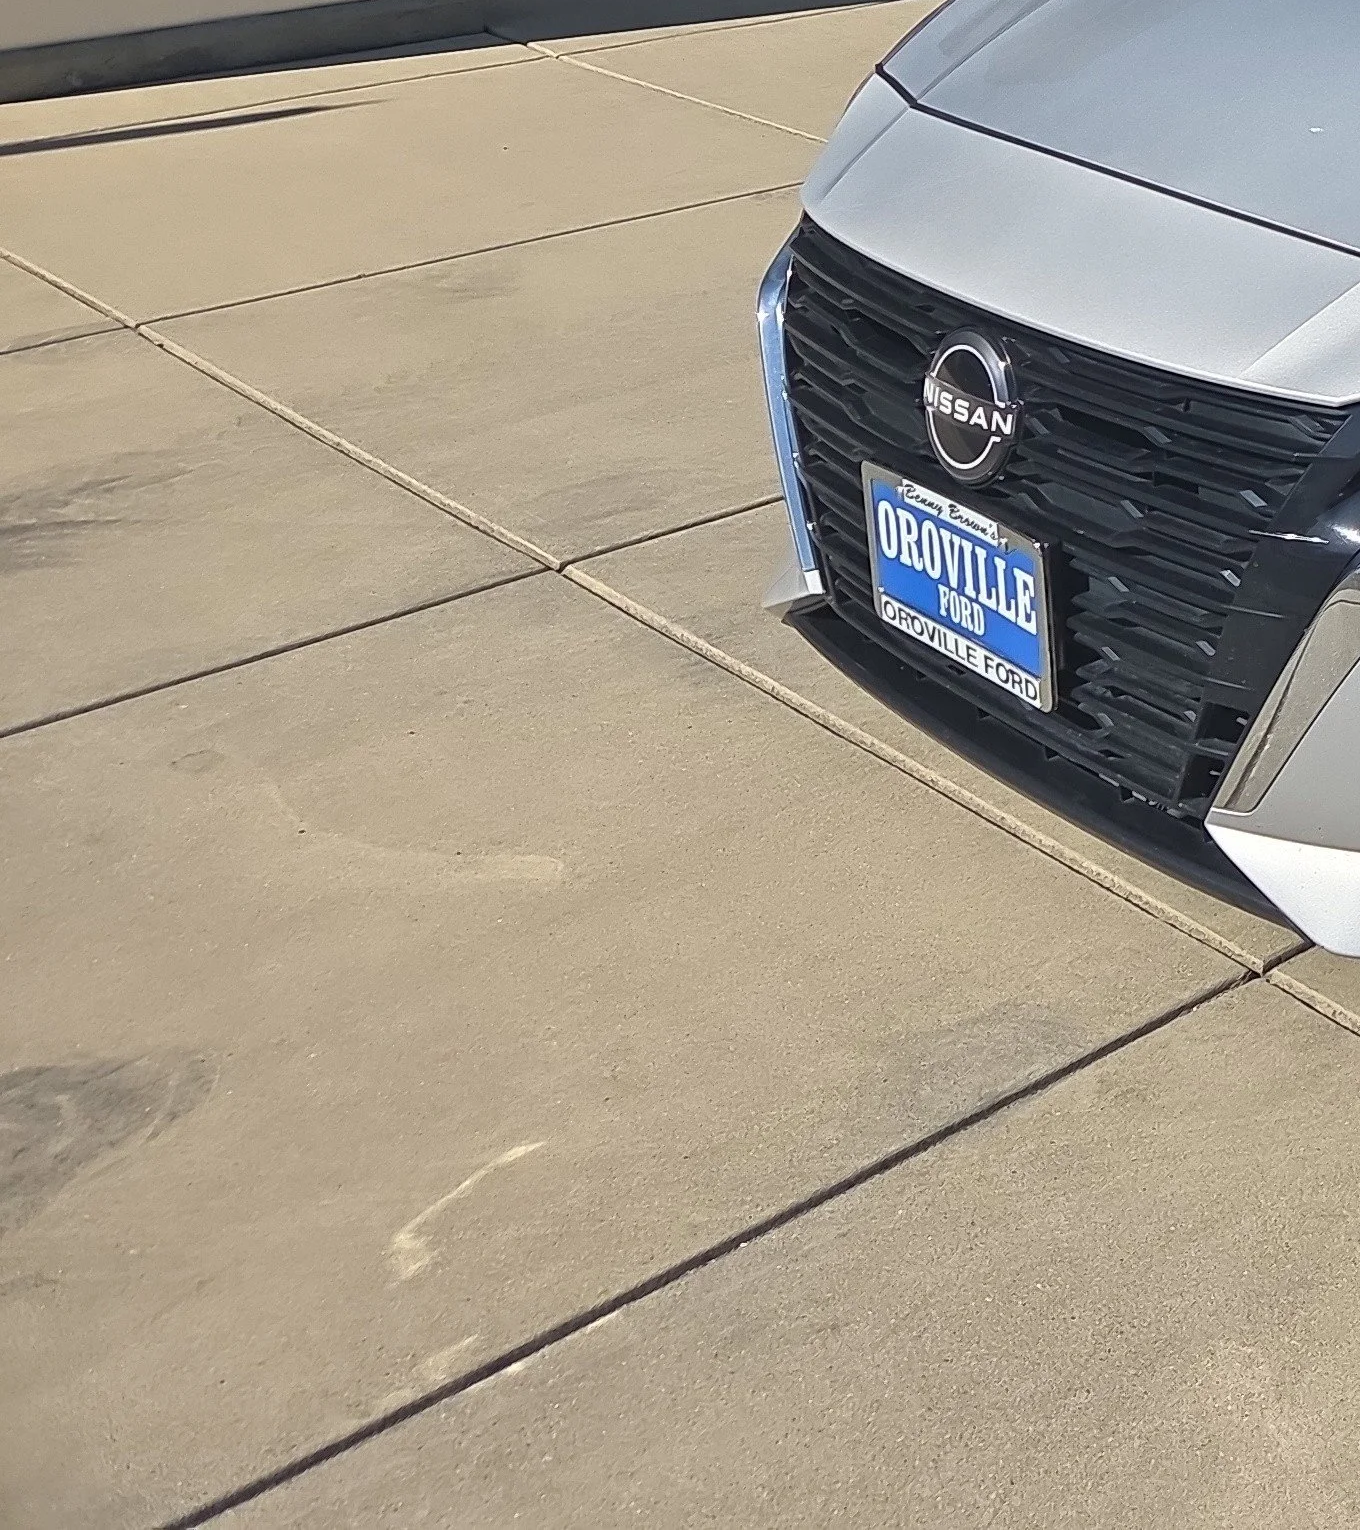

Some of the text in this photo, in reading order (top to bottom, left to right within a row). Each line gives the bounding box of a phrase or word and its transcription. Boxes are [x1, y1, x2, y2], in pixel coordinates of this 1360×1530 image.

[923, 376, 1014, 435] NISSAN
[877, 499, 1037, 636] OROVILLE
[883, 599, 1038, 702] OROVILLE FORD
[936, 583, 985, 637] FORD
